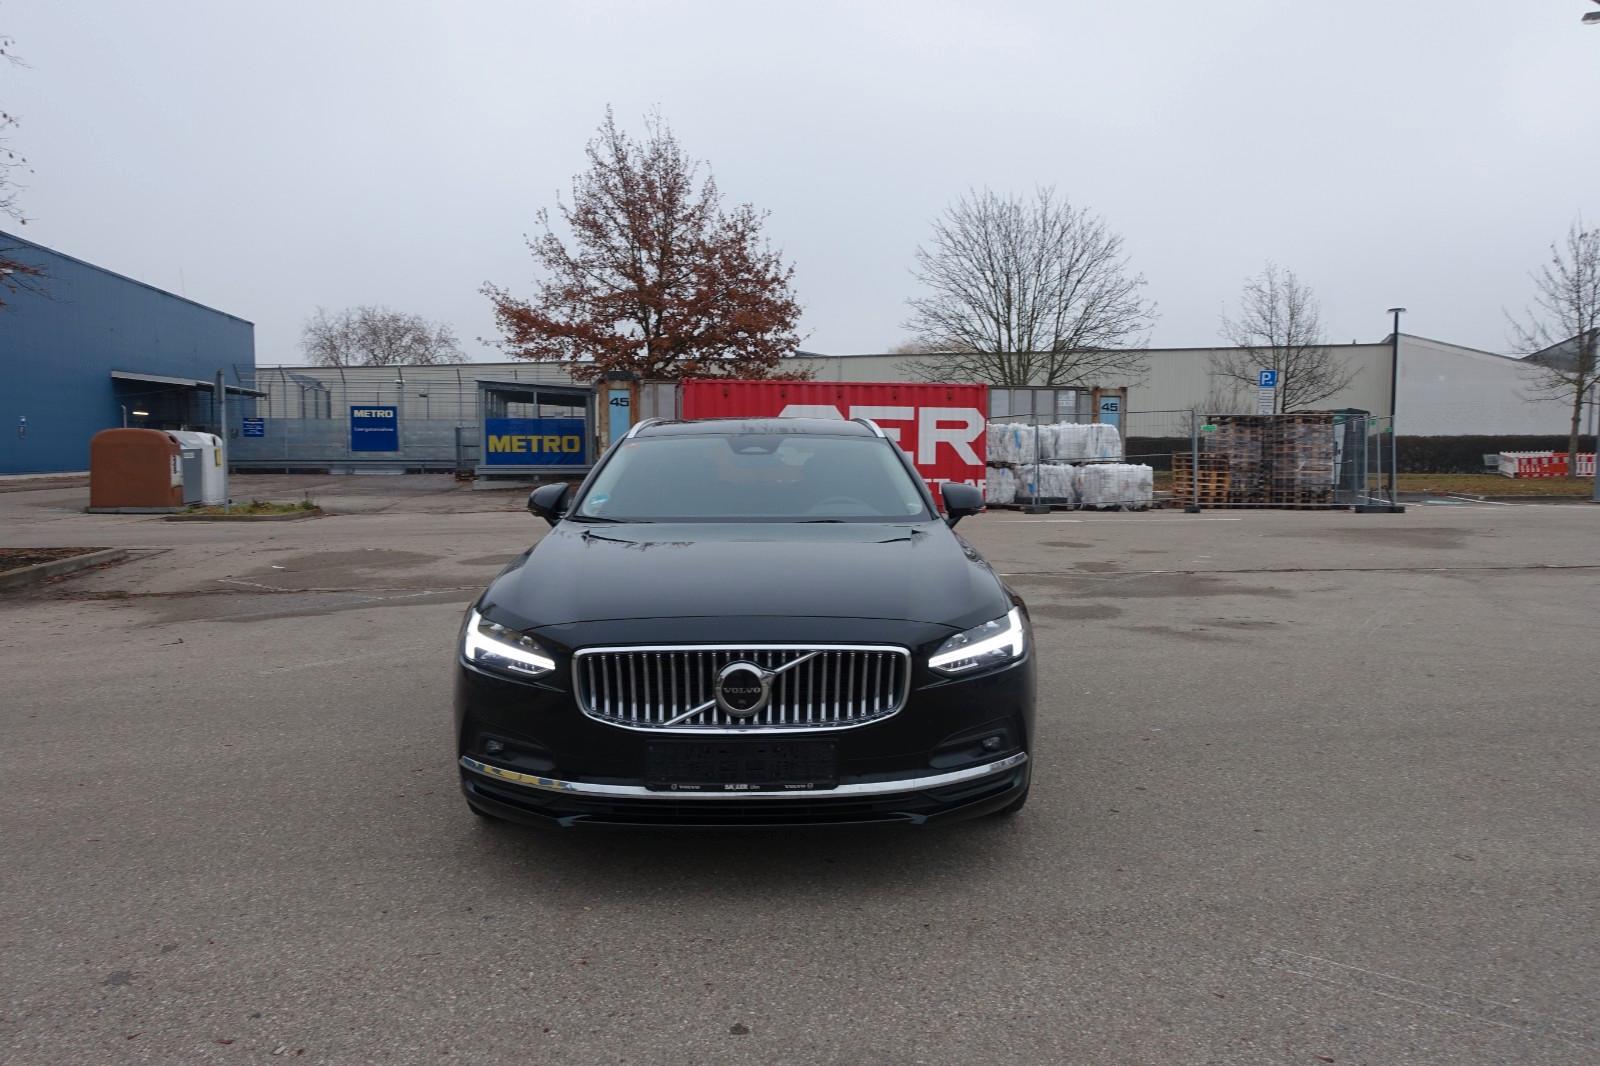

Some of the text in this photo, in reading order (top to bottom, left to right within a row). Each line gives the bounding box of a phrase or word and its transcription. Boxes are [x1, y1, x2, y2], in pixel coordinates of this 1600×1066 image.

[1261, 372, 1271, 385] P
[609, 398, 630, 407] 45
[1101, 402, 1119, 412] 45
[353, 409, 394, 418] METRO
[487, 435, 581, 453] METRO
